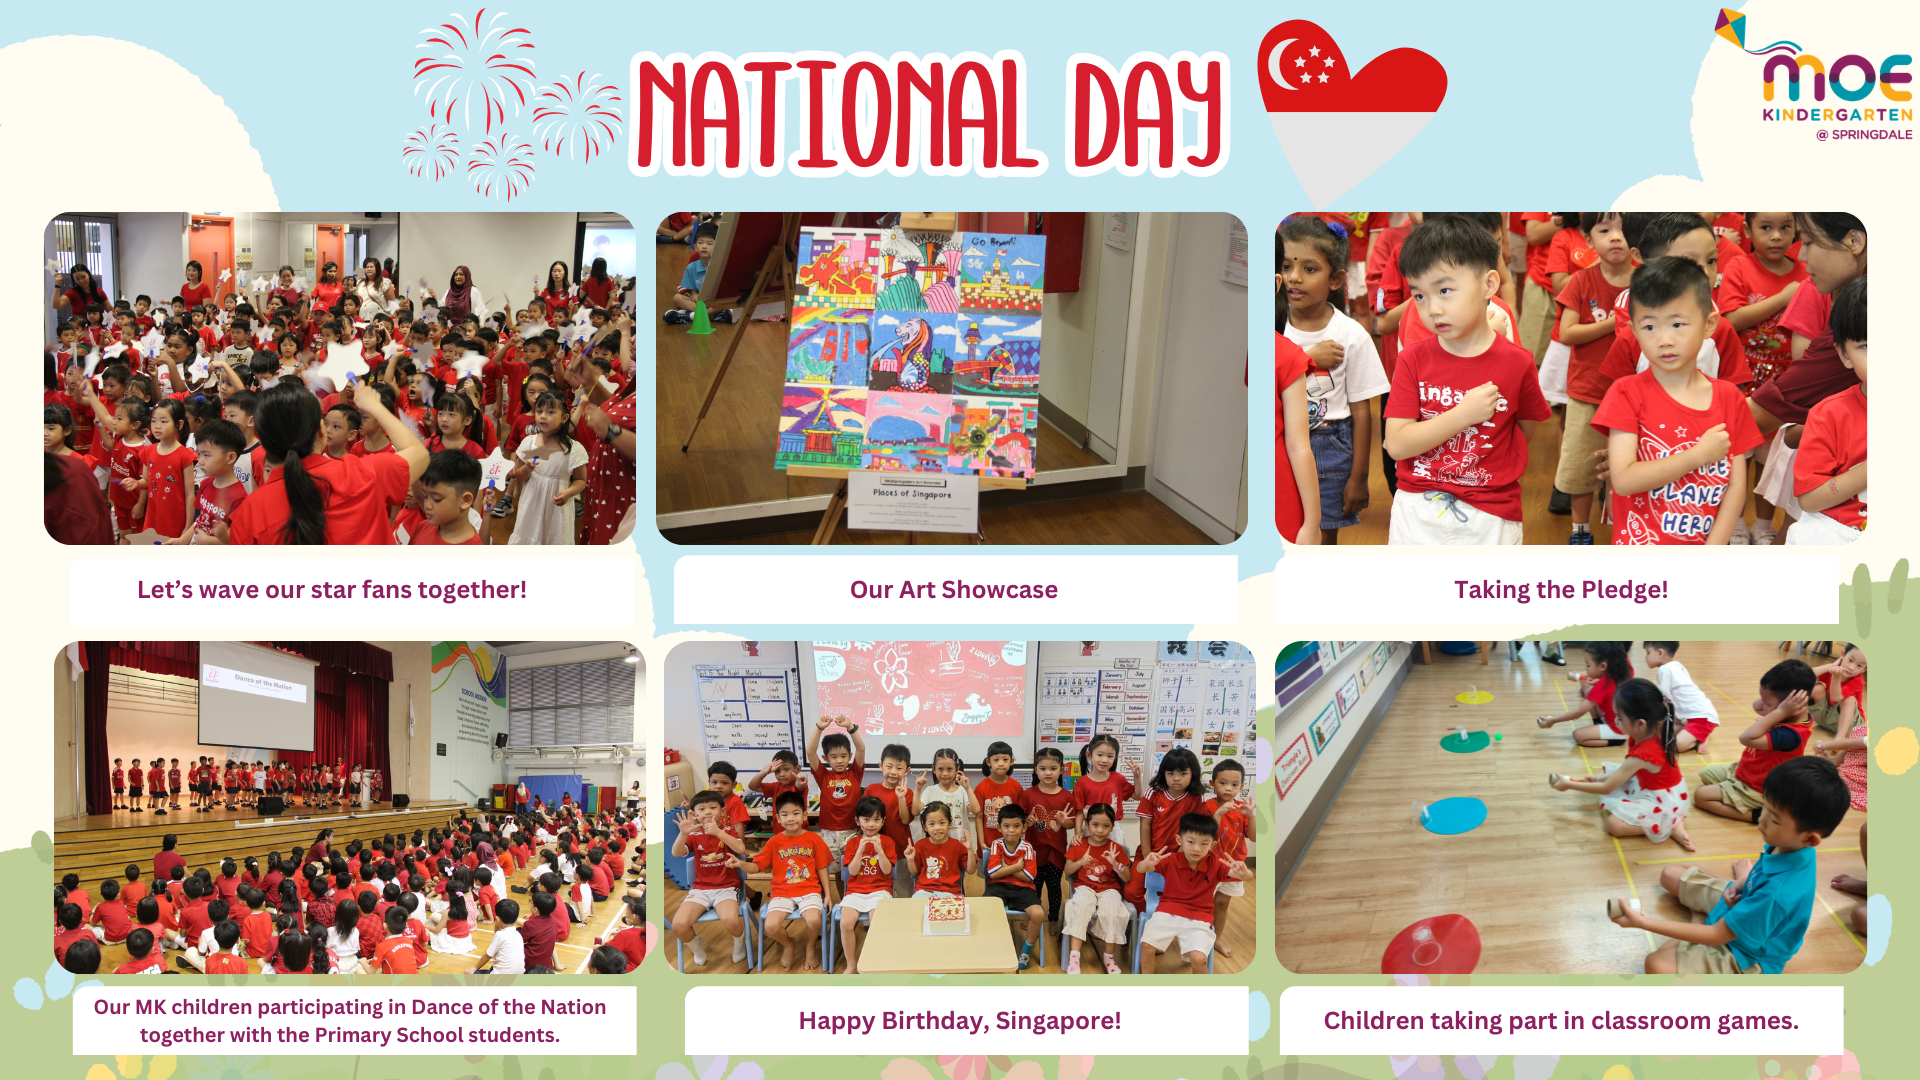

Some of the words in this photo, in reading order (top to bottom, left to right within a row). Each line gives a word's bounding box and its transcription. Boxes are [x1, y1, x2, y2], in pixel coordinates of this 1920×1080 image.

[972, 237, 986, 246] Go
[1419, 381, 1508, 412] ingae
[873, 489, 898, 497] Places
[912, 490, 952, 500] Singapore
[1651, 483, 1728, 505] PLANE
[1663, 512, 1713, 535] HERO
[235, 674, 254, 684] Dance
[274, 682, 292, 691] Nation
[461, 688, 474, 698] SCHOOL
[864, 867, 877, 875] SG
